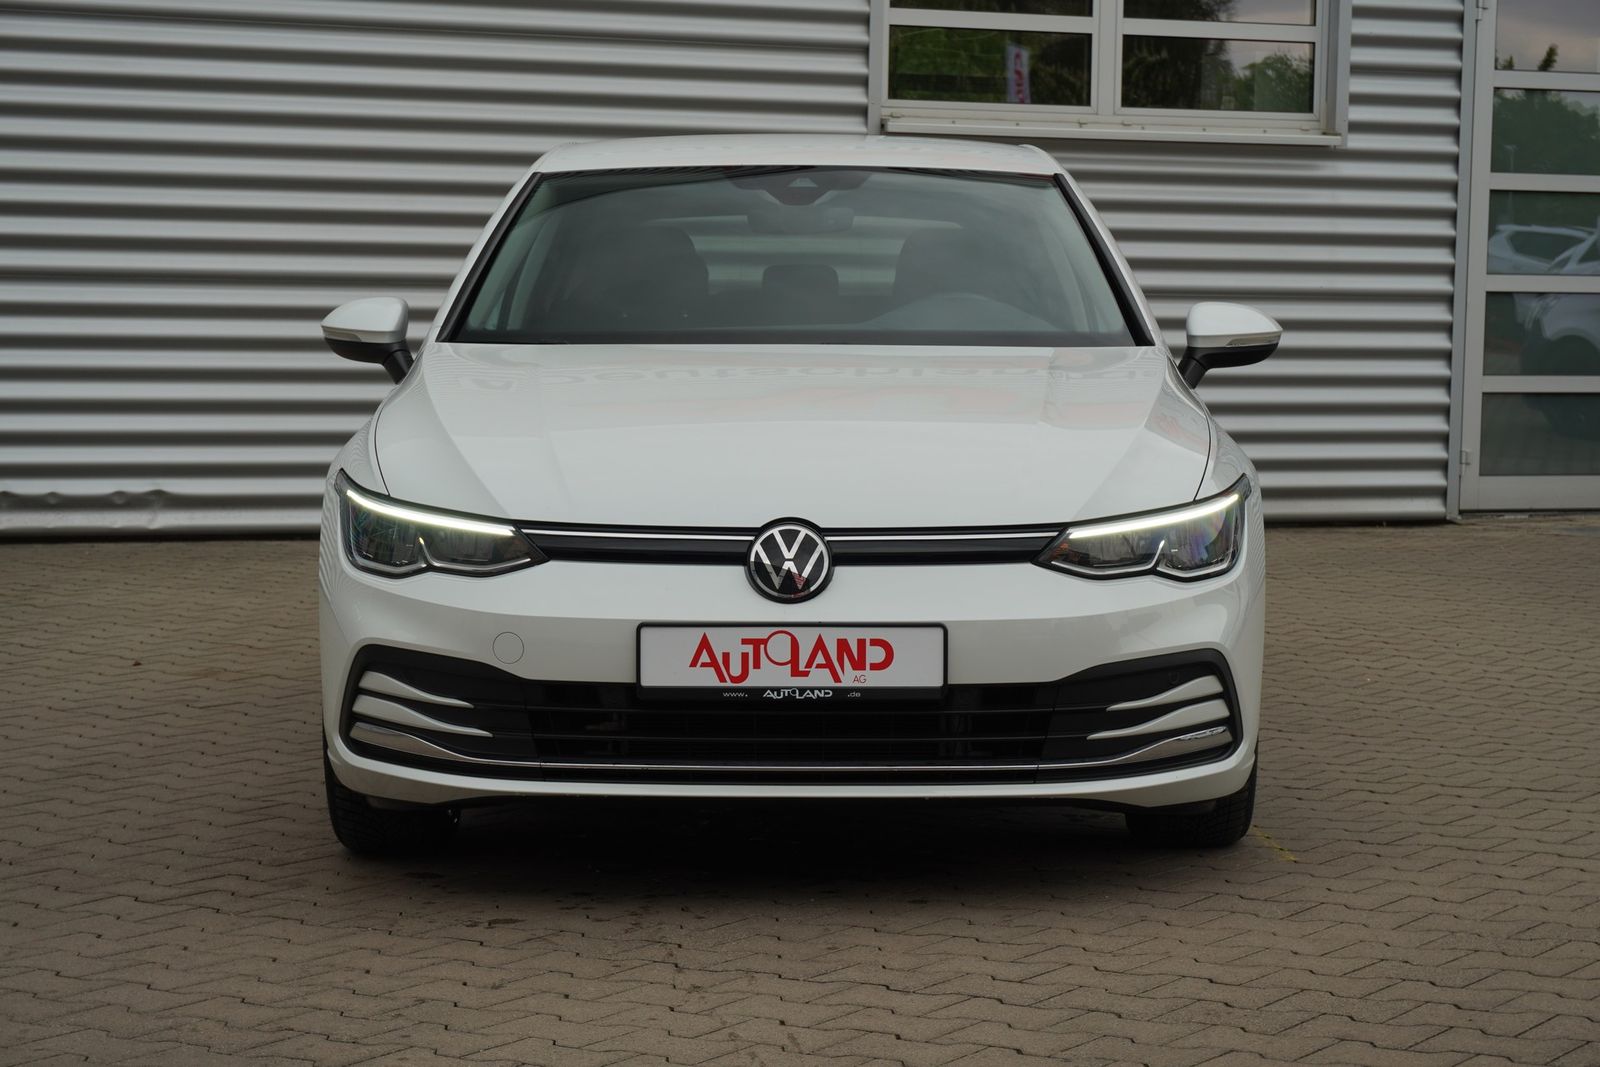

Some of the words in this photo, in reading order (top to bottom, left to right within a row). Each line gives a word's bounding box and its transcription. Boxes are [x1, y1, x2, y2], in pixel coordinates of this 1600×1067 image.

[690, 630, 894, 684] AUTOLAND
[852, 674, 867, 684] AG
[762, 688, 833, 699] AUTOLAND
